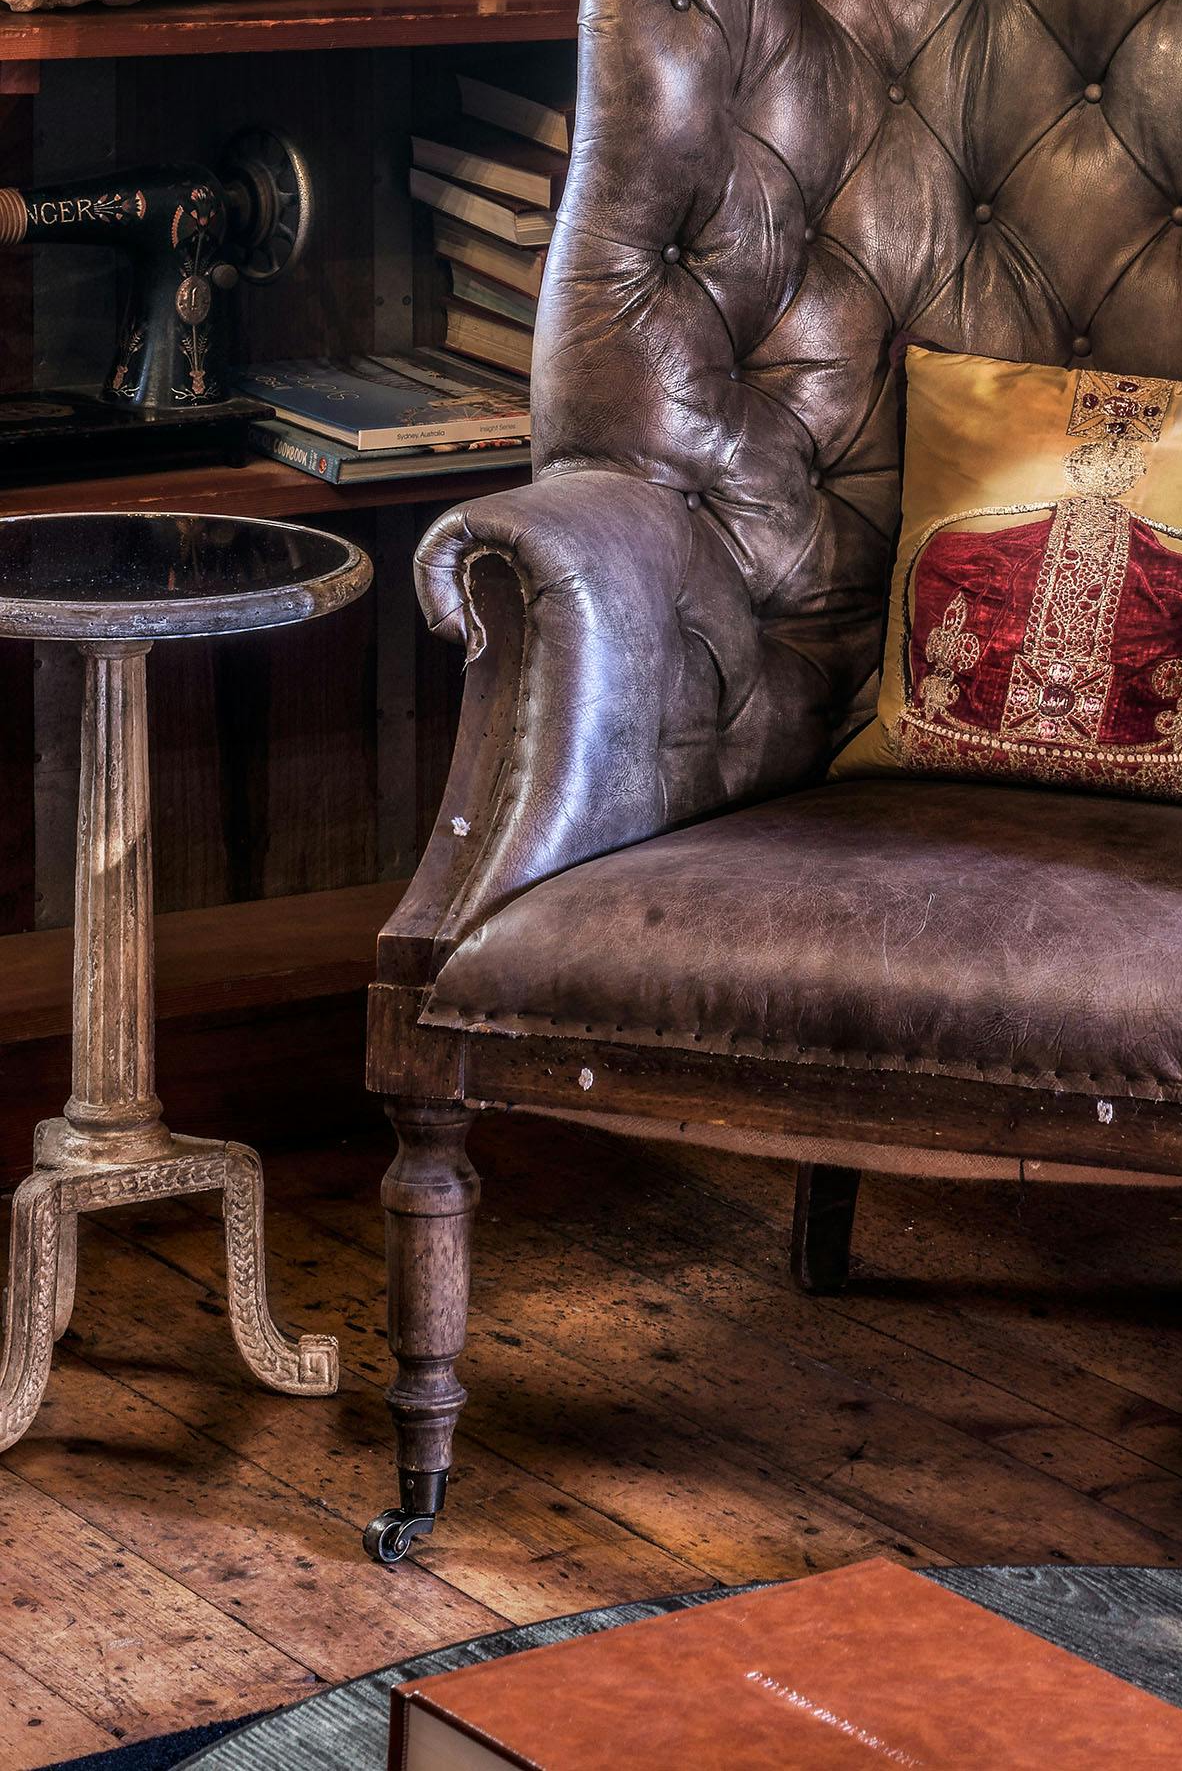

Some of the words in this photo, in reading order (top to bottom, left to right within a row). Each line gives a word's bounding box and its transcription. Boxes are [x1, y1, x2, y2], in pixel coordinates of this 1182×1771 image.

[26, 199, 96, 226] NGER
[479, 424, 500, 433] Insight
[500, 423, 517, 431] Series
[396, 429, 420, 441] Sydney,
[420, 429, 446, 439] Australia
